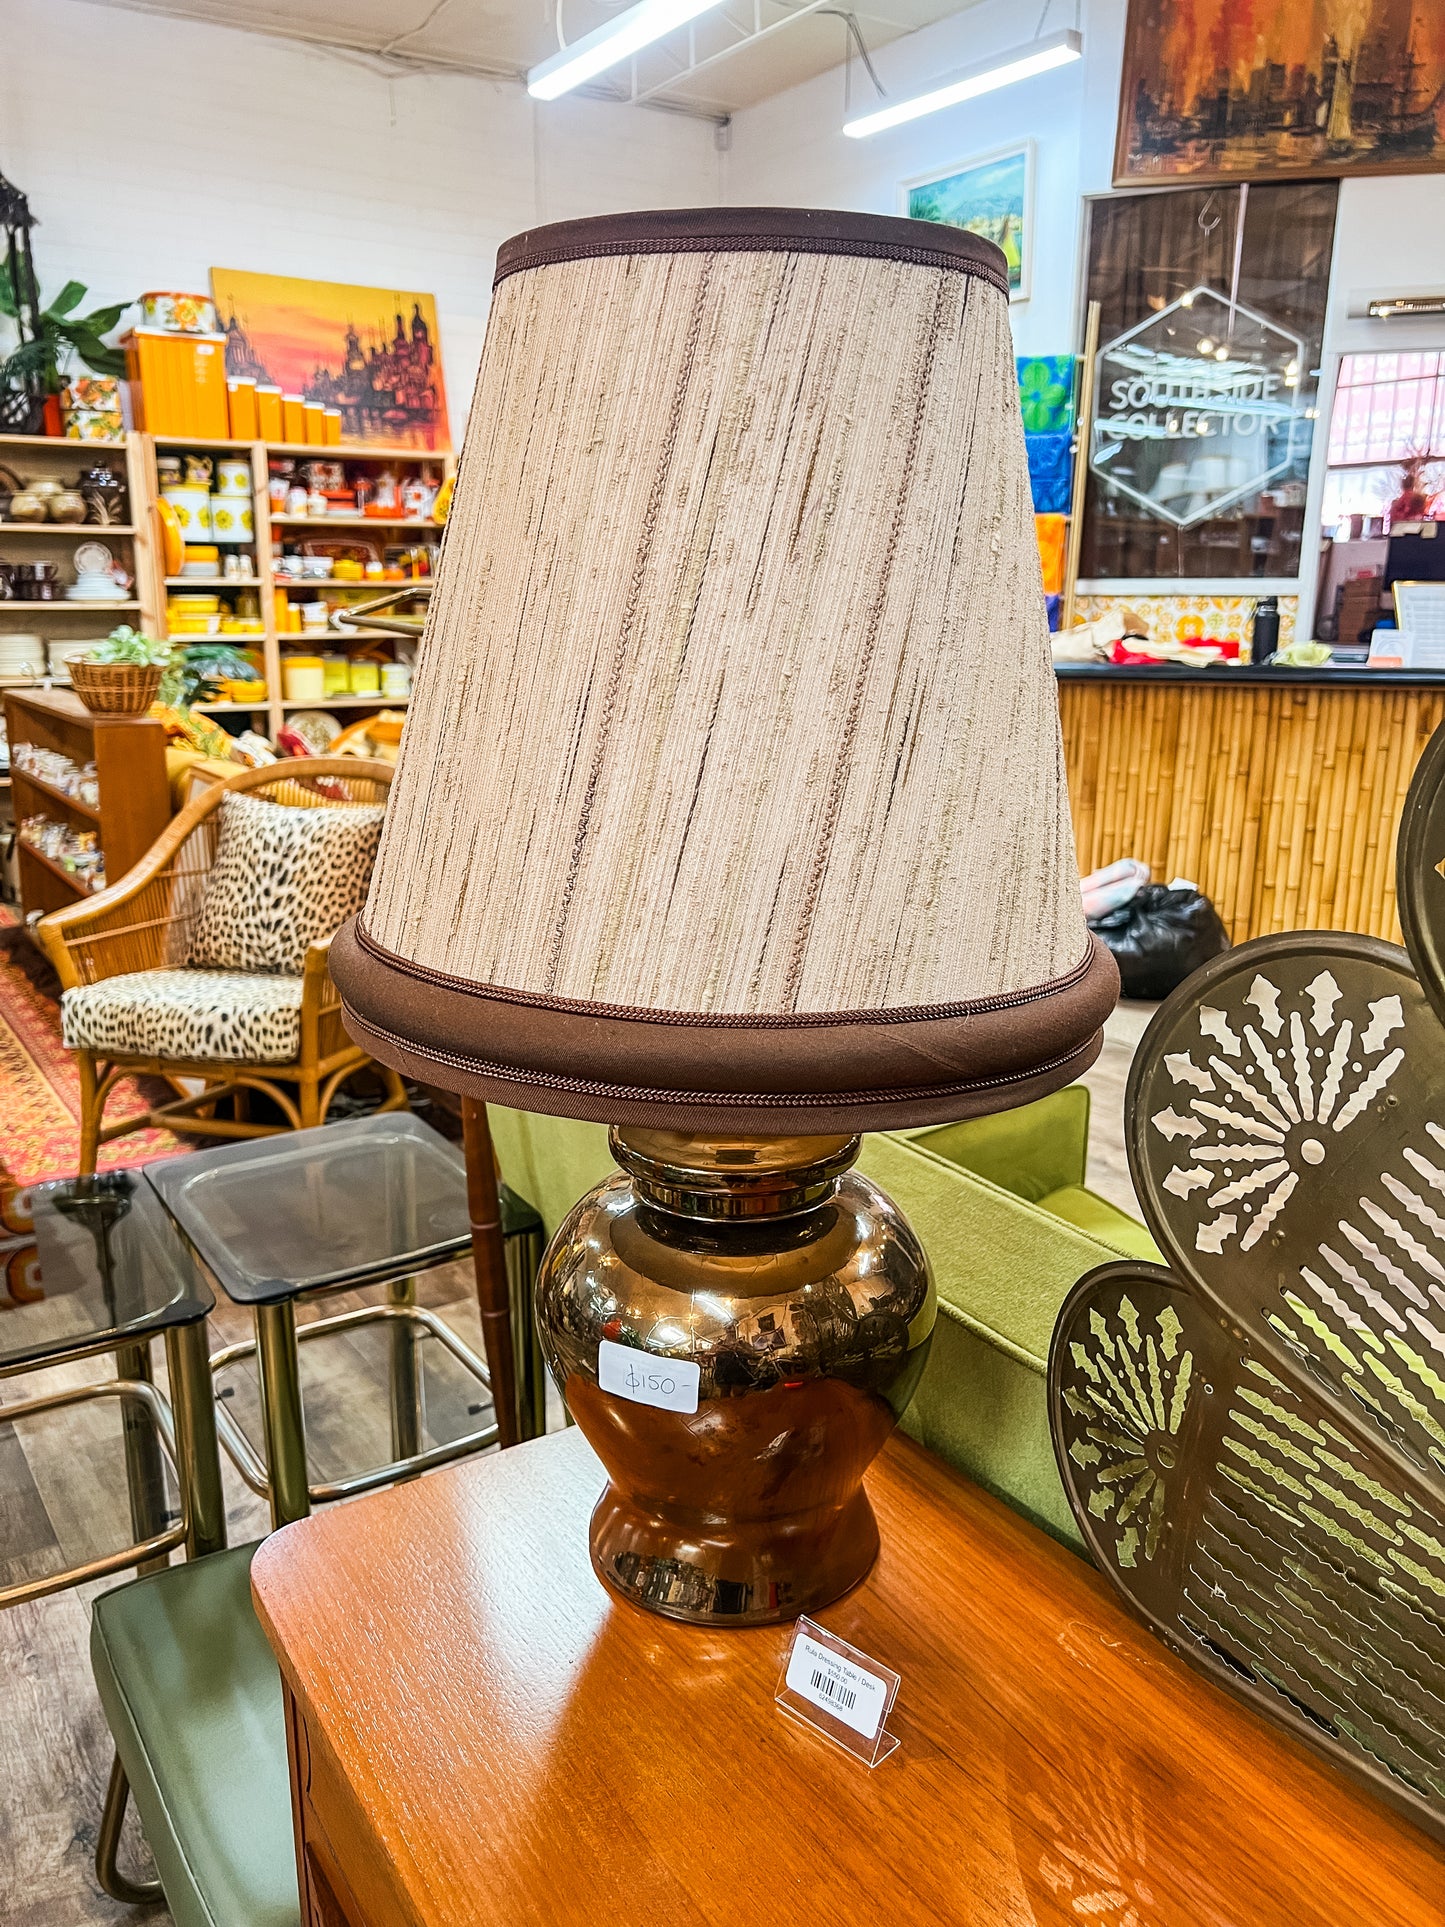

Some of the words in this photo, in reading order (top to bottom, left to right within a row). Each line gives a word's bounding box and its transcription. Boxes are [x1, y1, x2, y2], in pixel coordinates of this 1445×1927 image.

[1107, 410, 1280, 440] COLLECTOR
[818, 1652, 842, 1672] Dressing
[843, 1667, 857, 1680] Table
[861, 1678, 875, 1690] Desk
